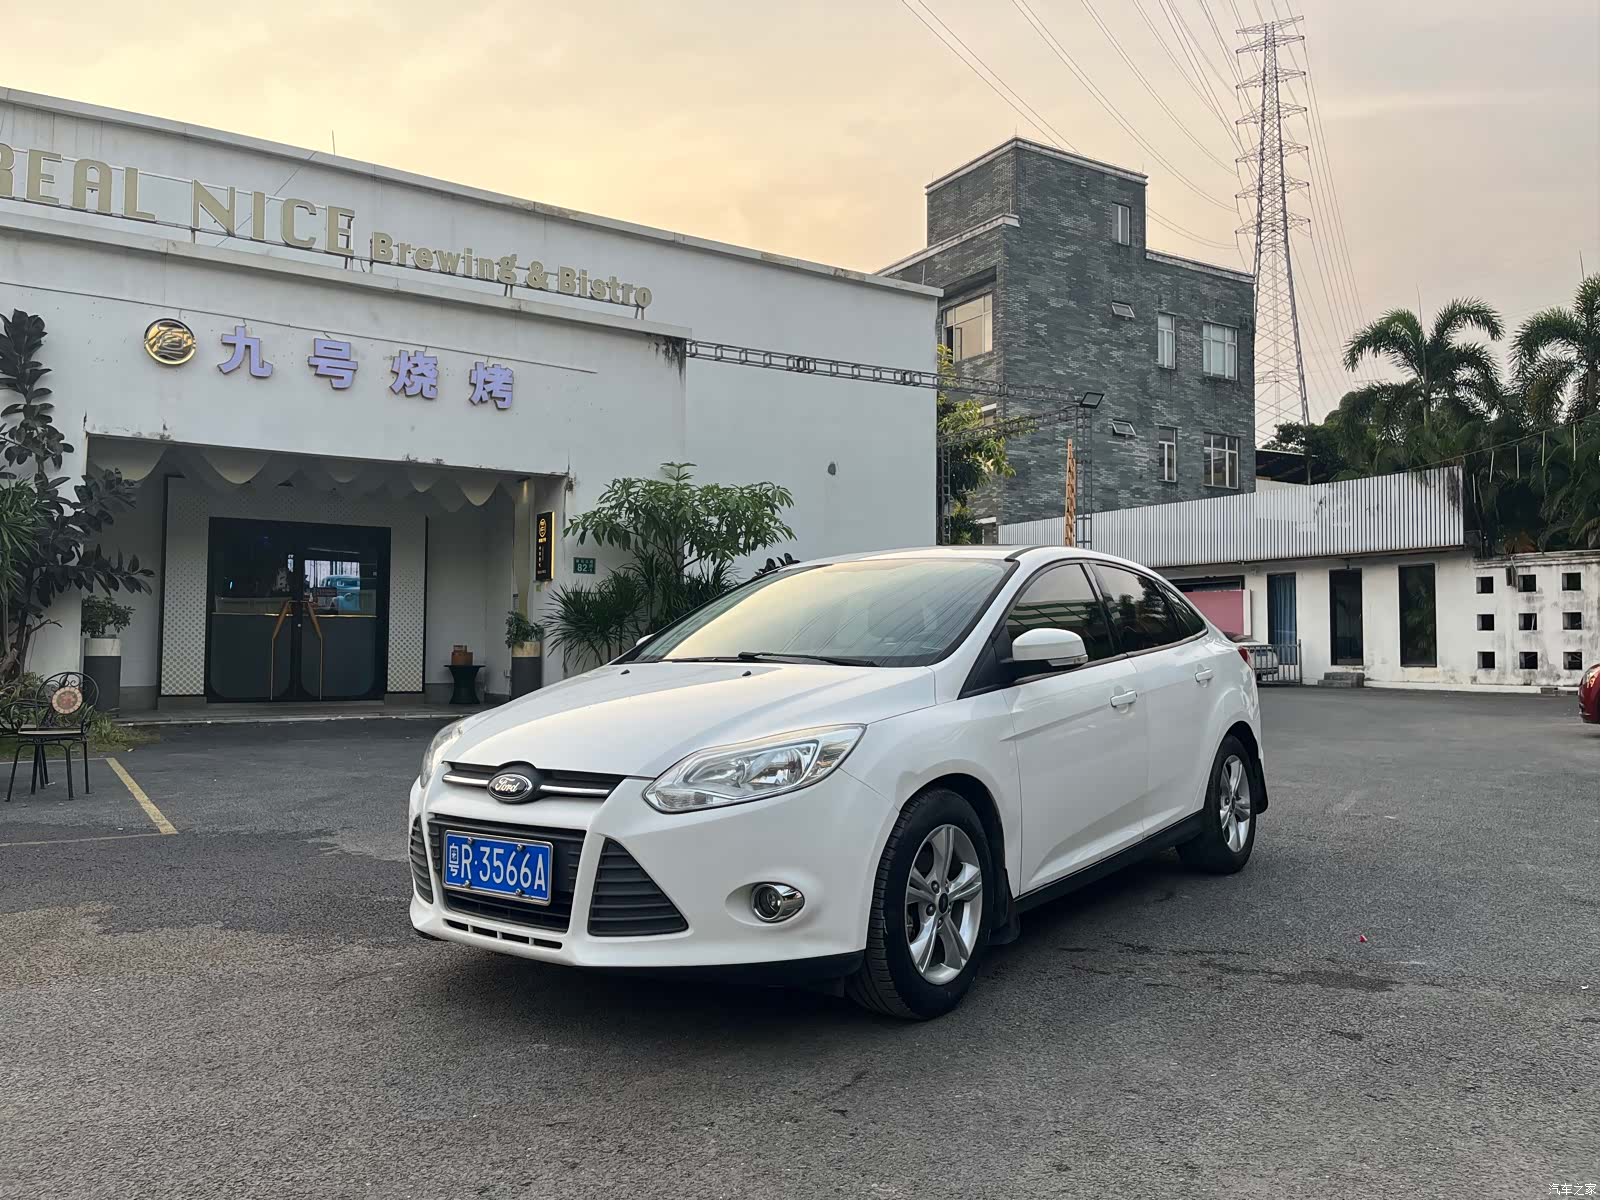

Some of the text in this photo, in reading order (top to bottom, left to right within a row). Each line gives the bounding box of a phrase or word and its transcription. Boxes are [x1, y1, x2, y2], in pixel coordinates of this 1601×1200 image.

[191, 179, 355, 256] NICE
[372, 231, 518, 285] Brewing
[527, 261, 549, 290] &
[558, 265, 652, 309] Bistro
[217, 325, 515, 410] 九号烧烤
[494, 776, 519, 793] Ford
